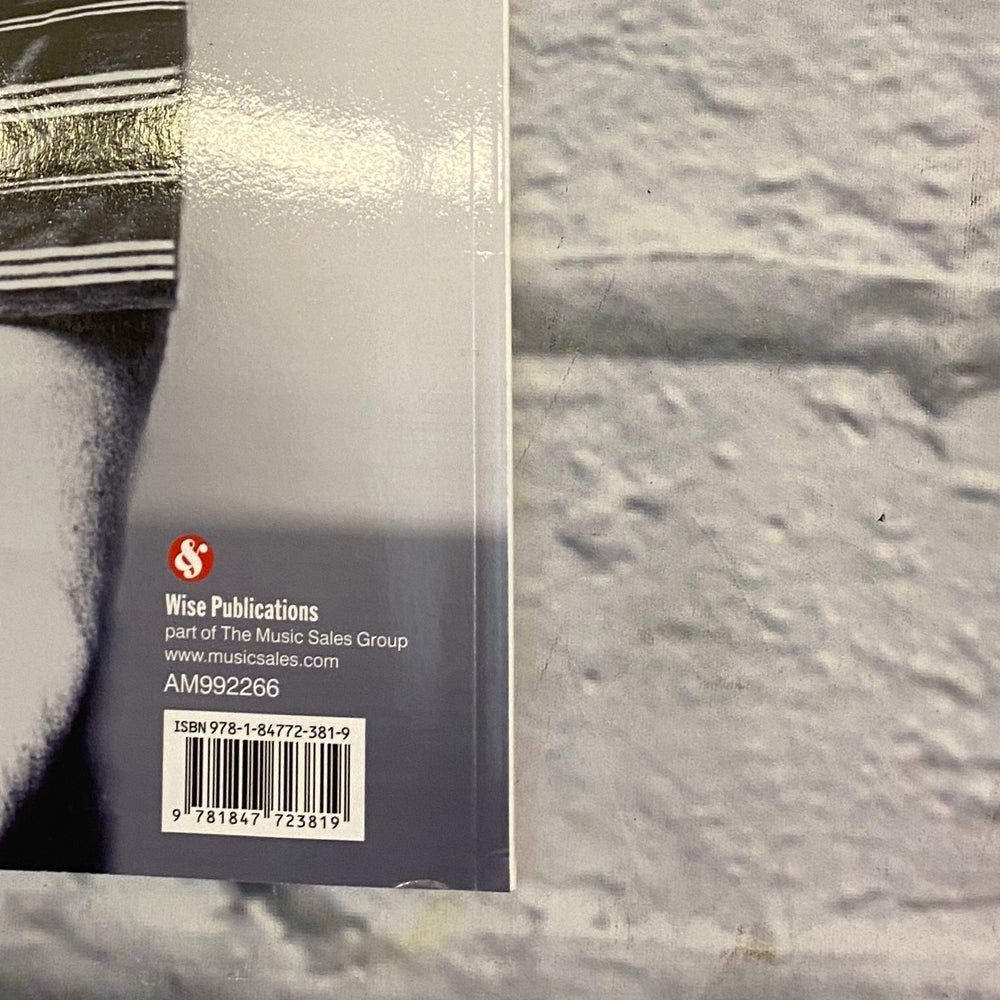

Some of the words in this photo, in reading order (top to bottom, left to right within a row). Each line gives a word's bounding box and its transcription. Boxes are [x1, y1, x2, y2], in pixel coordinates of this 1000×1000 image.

[165, 593, 206, 617] Wise
[211, 595, 319, 622] Publications
[165, 626, 196, 642] part
[201, 626, 217, 641] of
[221, 626, 252, 642] The
[256, 628, 304, 645] Music
[308, 629, 352, 646] Sales
[357, 631, 408, 651] Group
[165, 649, 339, 668] www.musicsales.com
[163, 674, 280, 697] AM992266
[174, 720, 207, 734] ISBN
[209, 721, 350, 740] 978-1-84772-381-9
[172, 809, 181, 821] 9
[196, 810, 260, 826] 781847
[275, 812, 340, 829] 723819
